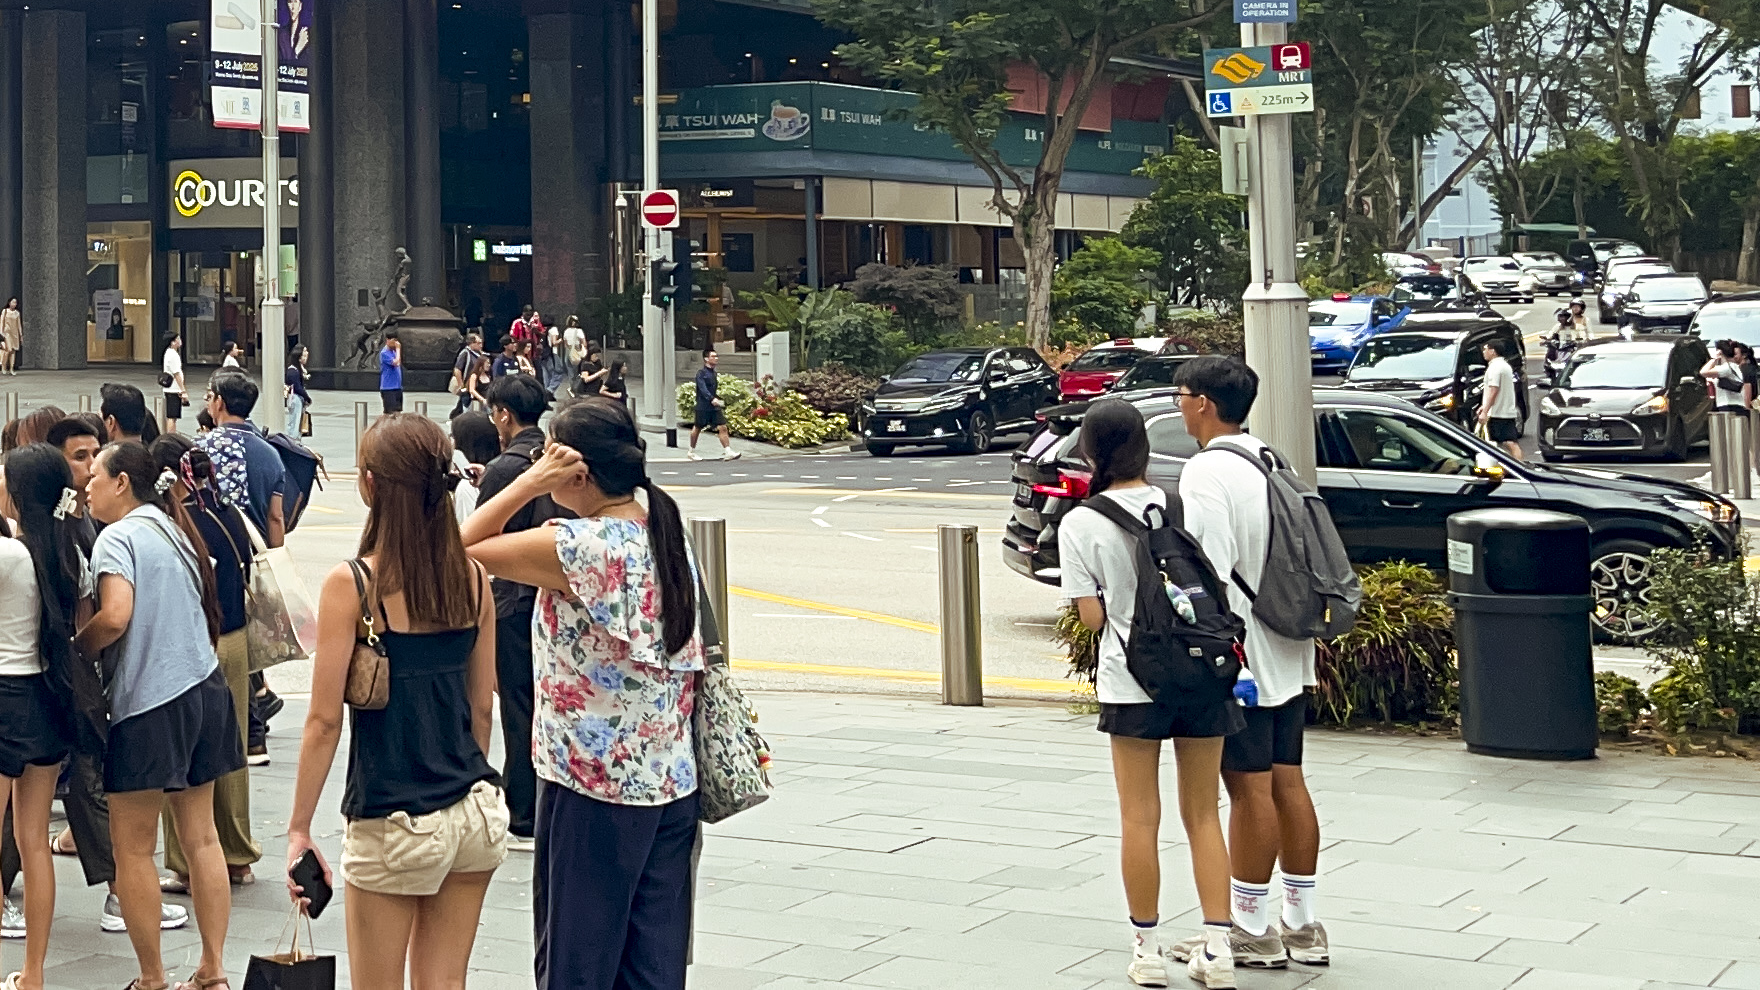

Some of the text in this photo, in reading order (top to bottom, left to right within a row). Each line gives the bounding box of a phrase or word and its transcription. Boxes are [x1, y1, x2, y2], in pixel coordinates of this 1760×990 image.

[1242, 2, 1278, 10] CAMERA
[1242, 9, 1289, 17] OPERATION
[232, 60, 243, 73] July
[1279, 70, 1306, 82] MRT
[1261, 94, 1293, 106] 225m
[682, 112, 758, 127] TSUI WAH
[840, 111, 882, 126] TSUI WAH
